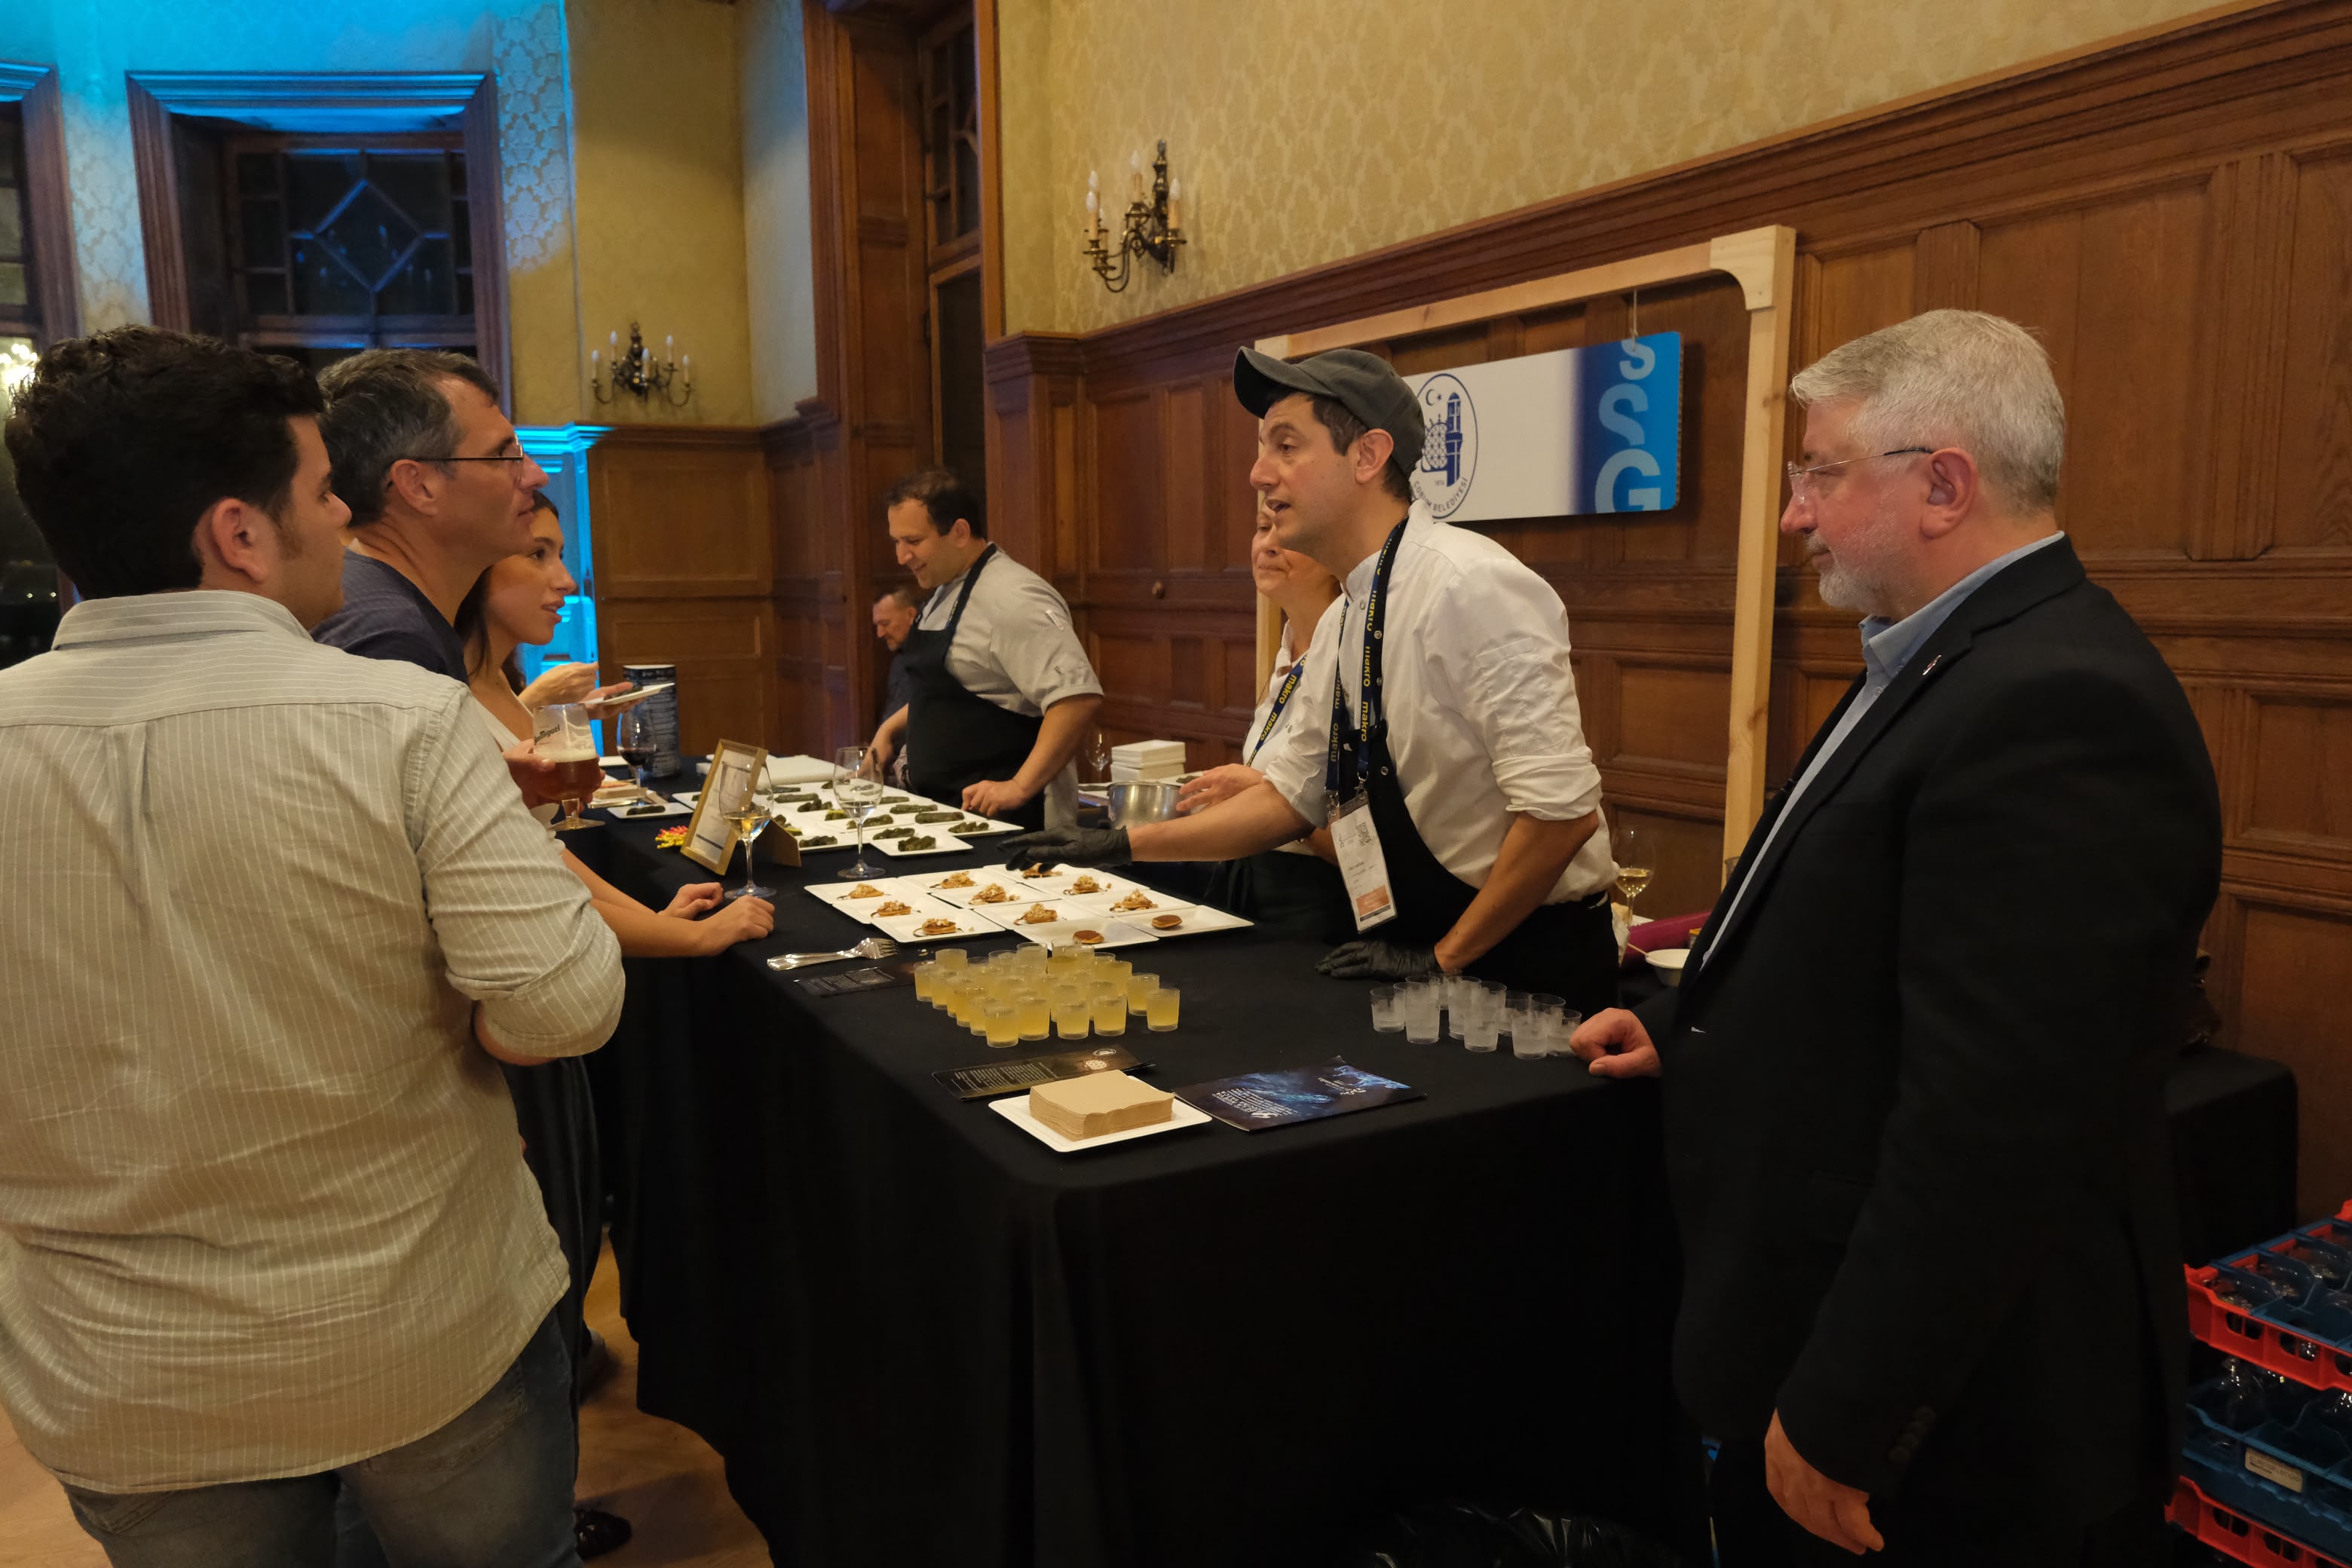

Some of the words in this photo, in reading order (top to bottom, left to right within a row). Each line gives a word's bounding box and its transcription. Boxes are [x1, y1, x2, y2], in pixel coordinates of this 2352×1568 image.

[1279, 675, 1297, 704] makro
[1260, 712, 1278, 741] makro
[1361, 701, 1369, 743] makro
[1331, 723, 1339, 762] makro
